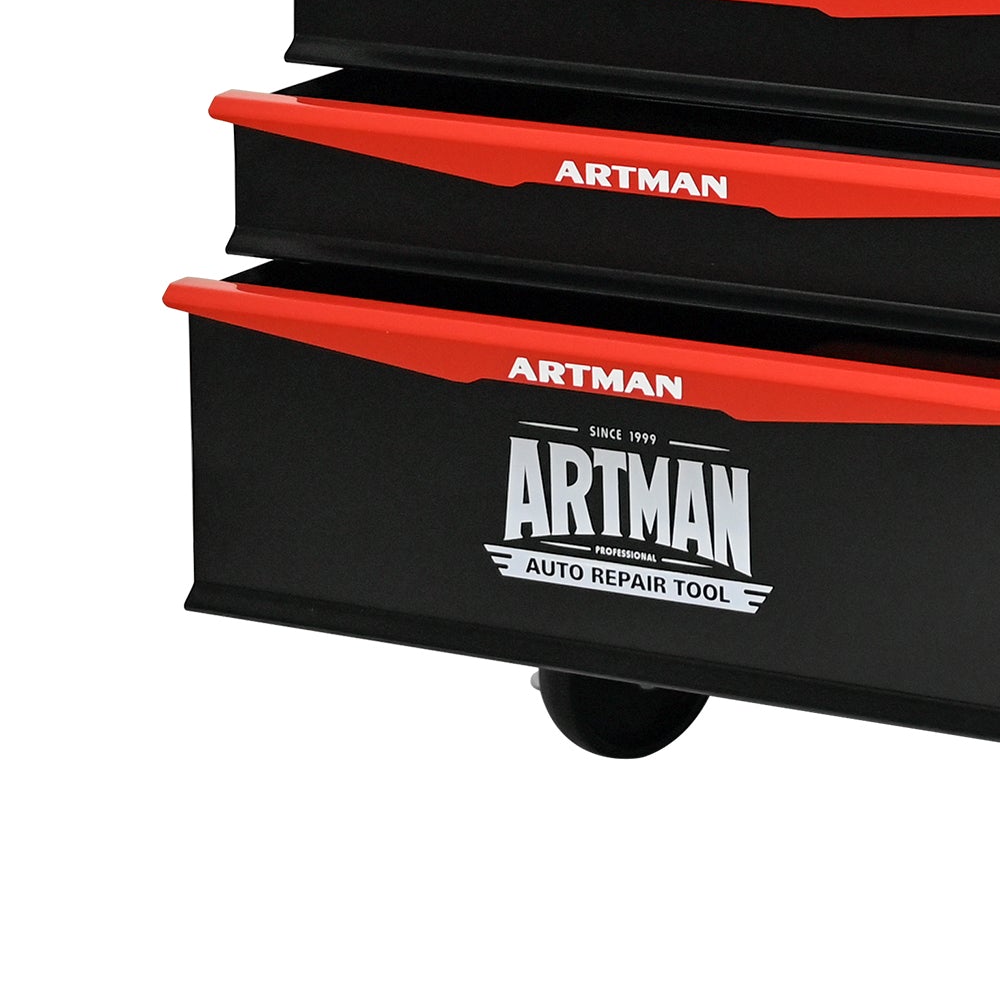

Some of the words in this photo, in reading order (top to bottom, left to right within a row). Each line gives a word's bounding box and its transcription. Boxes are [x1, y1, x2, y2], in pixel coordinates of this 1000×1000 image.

[555, 161, 727, 199] ARTMAN
[508, 357, 682, 399] ARTMAN
[589, 425, 622, 441] SINCE
[629, 431, 657, 445] 1999
[503, 436, 752, 577] ARTMAN
[595, 545, 657, 563] PROFESSIONAL
[526, 557, 584, 581] AUTO
[592, 567, 667, 594] REPAIR
[673, 579, 730, 604] TOOL
